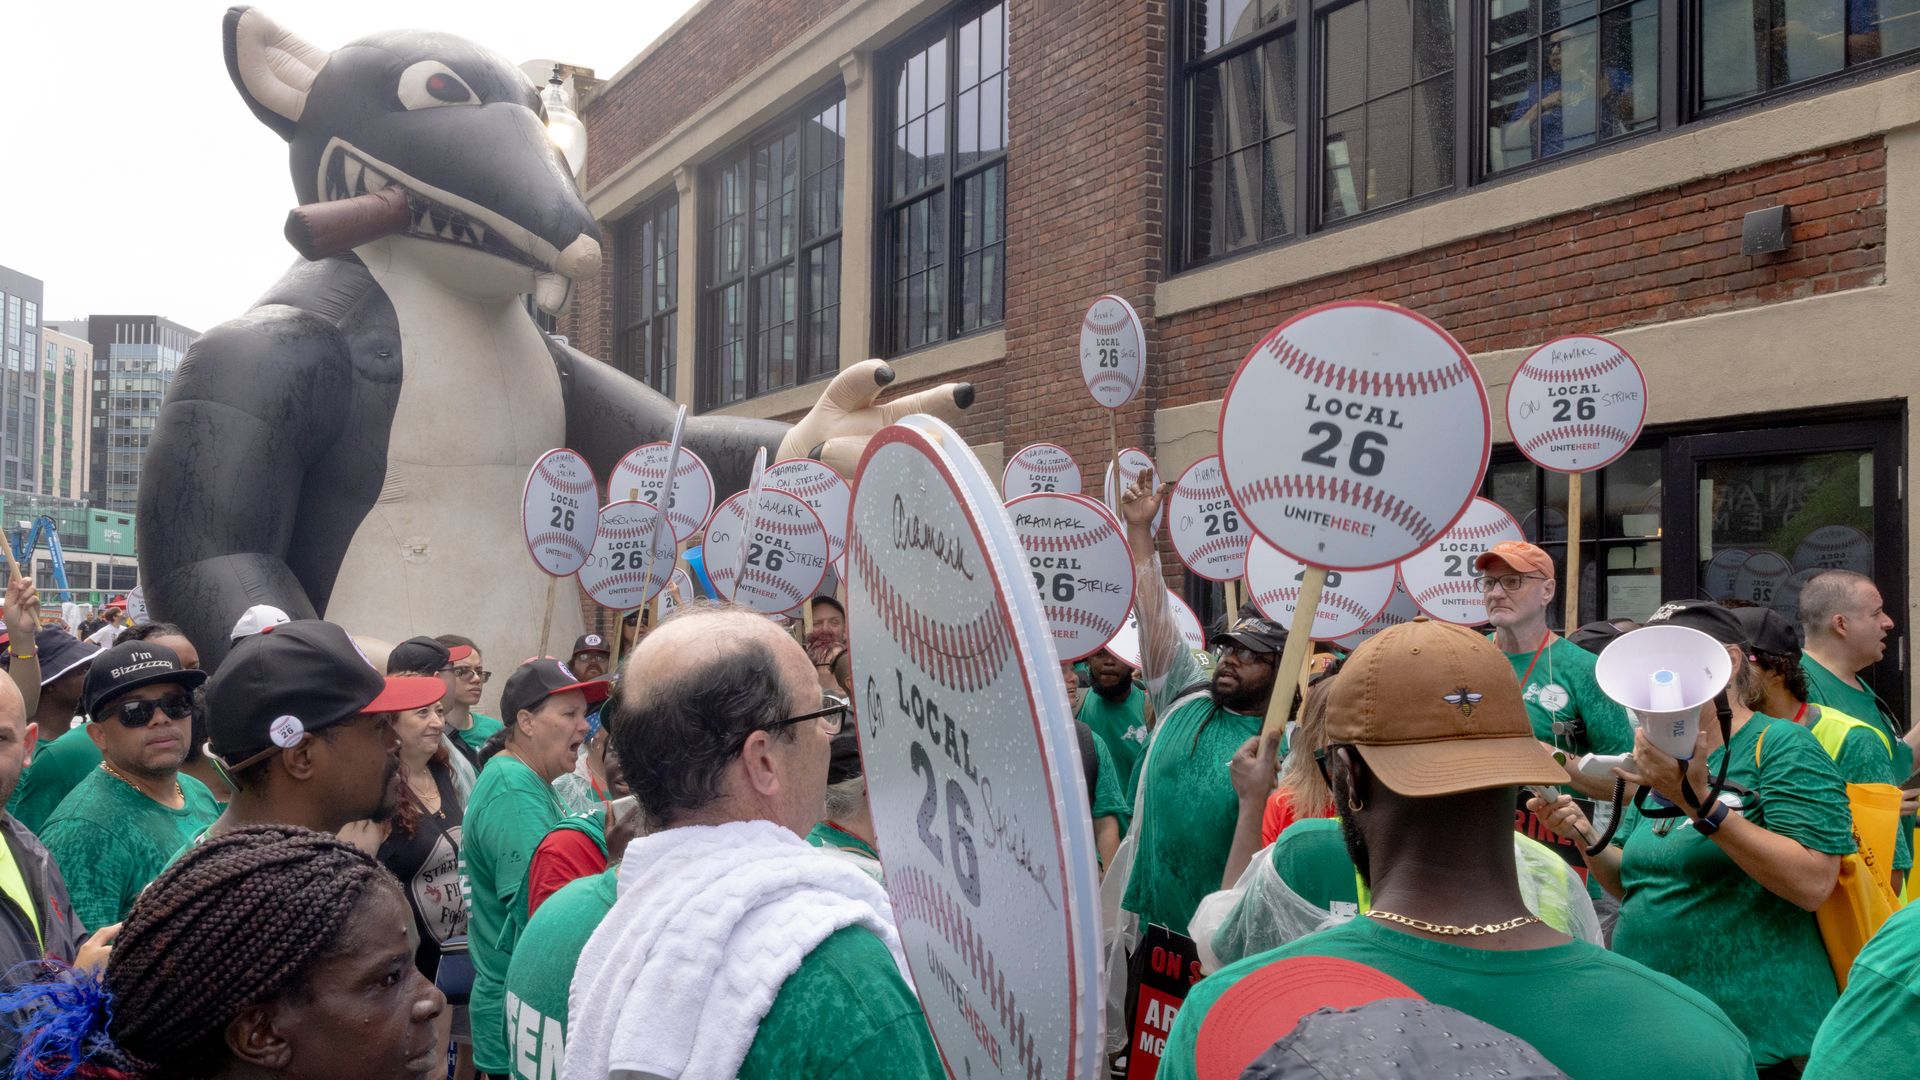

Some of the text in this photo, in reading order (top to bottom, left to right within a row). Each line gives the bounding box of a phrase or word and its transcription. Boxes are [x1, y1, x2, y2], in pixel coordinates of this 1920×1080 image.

[1097, 338, 1120, 346] LOCAL
[1099, 349, 1119, 368] 26
[1548, 384, 1600, 396] LOCAL
[1602, 391, 1638, 407] STRIKE
[1305, 393, 1403, 429] LOCAL
[1553, 397, 1596, 422] 26
[1301, 421, 1388, 477] 26
[1550, 443, 1600, 452] UNITEHERE!
[641, 481, 680, 490] LOCL
[1029, 474, 1059, 482] LOCAL
[551, 493, 579, 509] LOCAL
[759, 497, 804, 519] AMARK
[1199, 500, 1231, 513] LOCA
[550, 506, 575, 532] 26
[1016, 514, 1085, 529] ARAMARK
[1204, 511, 1238, 536] 26
[1284, 505, 1375, 537] UNITEHERE!
[609, 541, 646, 550] LOCAL
[755, 533, 791, 550] OCAL
[1440, 543, 1488, 552] LOCAL
[546, 547, 572, 560] UNITEHERE!
[611, 551, 643, 571] 26
[748, 543, 784, 571] 26
[786, 551, 825, 568] STRIKE
[1030, 557, 1081, 569] OCAL
[1444, 555, 1484, 577] 26
[739, 584, 777, 599] NITEHERE!
[1077, 579, 1122, 593] STRIKE
[1051, 630, 1078, 639] HERE!
[281, 728, 294, 739] 26
[896, 668, 978, 786] LOCAL
[910, 741, 981, 908] 26
[1151, 946, 1182, 979] ON
[927, 941, 1004, 1076] UNITEHERE!
